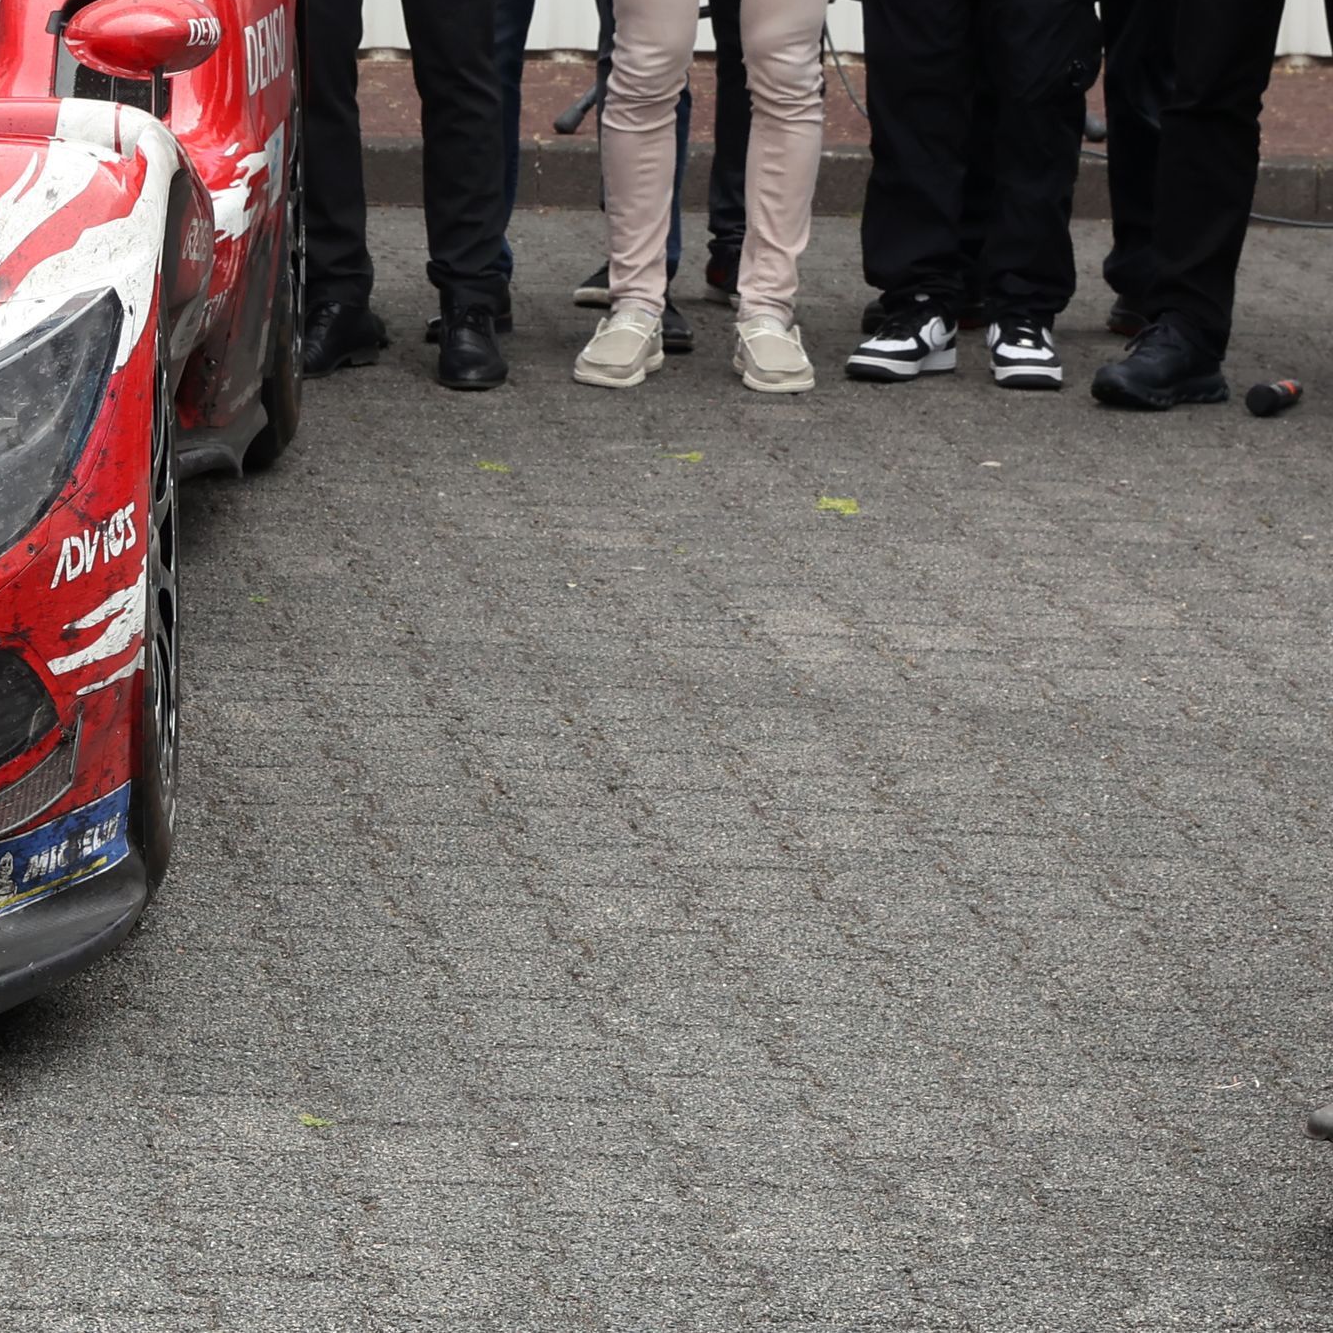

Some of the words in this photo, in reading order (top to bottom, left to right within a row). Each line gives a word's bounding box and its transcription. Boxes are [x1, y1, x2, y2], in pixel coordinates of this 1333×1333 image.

[186, 17, 222, 46] DEN
[244, 3, 286, 97] DENSO
[21, 811, 122, 883] MICELIN
